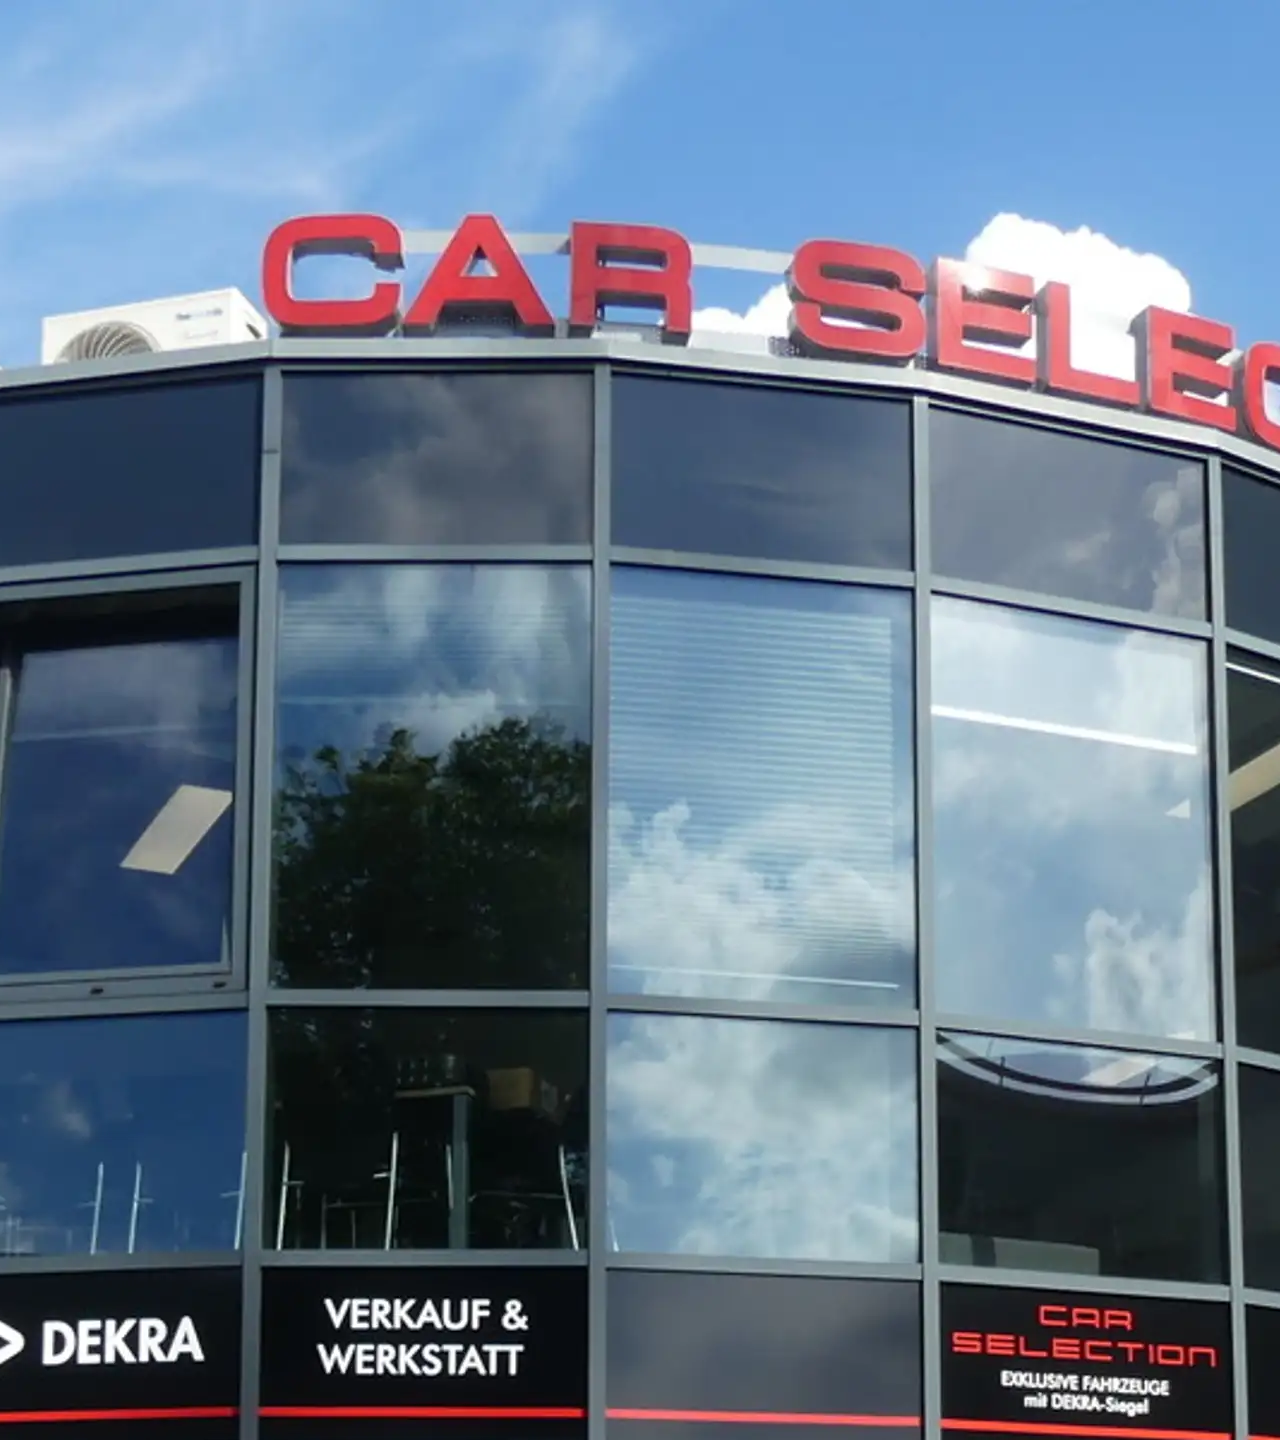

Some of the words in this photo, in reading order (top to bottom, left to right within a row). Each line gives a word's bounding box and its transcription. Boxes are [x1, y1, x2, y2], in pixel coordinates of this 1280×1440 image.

[261, 212, 693, 338] CAR
[324, 1297, 490, 1331] VERKAUF
[500, 1298, 528, 1331] &
[1037, 1304, 1135, 1331] CAR
[41, 1315, 205, 1366] DEKRA
[950, 1330, 1219, 1367] SELECTION
[316, 1342, 524, 1376] WERKSTATT
[1000, 1370, 1079, 1392] EXKLUSIVE
[1081, 1374, 1170, 1398] FAHRZEUGE
[1023, 1391, 1048, 1409] mit
[1050, 1392, 1150, 1418] DEKRA-Siegel
